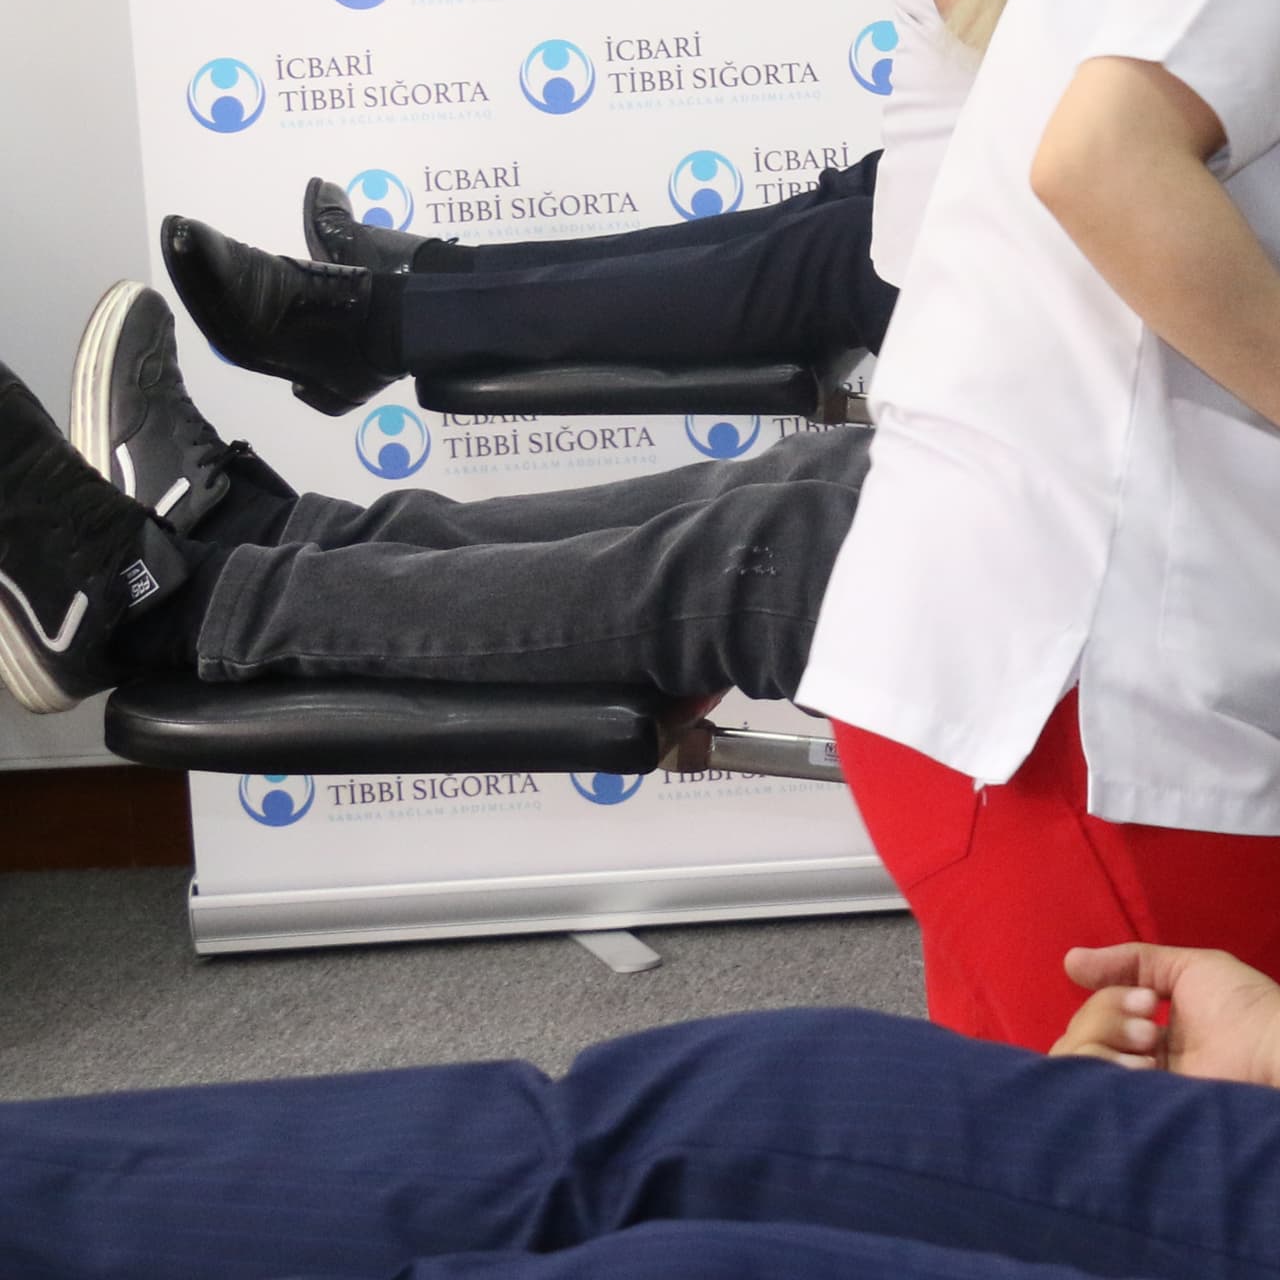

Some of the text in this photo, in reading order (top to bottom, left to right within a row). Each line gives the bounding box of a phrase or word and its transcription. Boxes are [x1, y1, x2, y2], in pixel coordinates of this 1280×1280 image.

[605, 31, 702, 62] İCBARİ
[275, 49, 374, 81] İCBARİ
[608, 61, 820, 94] TİBBİ SIĞORTA
[278, 80, 490, 112] TİBBİ SIĞORTA
[753, 141, 849, 173] İCBARİ
[424, 161, 521, 192] İCBARİ
[756, 178, 820, 205] TİB
[427, 191, 639, 224] TİBBİ SIĞORTA
[443, 426, 655, 459] TİBBİ SIĞORTA
[328, 776, 405, 806] TİBBİ
